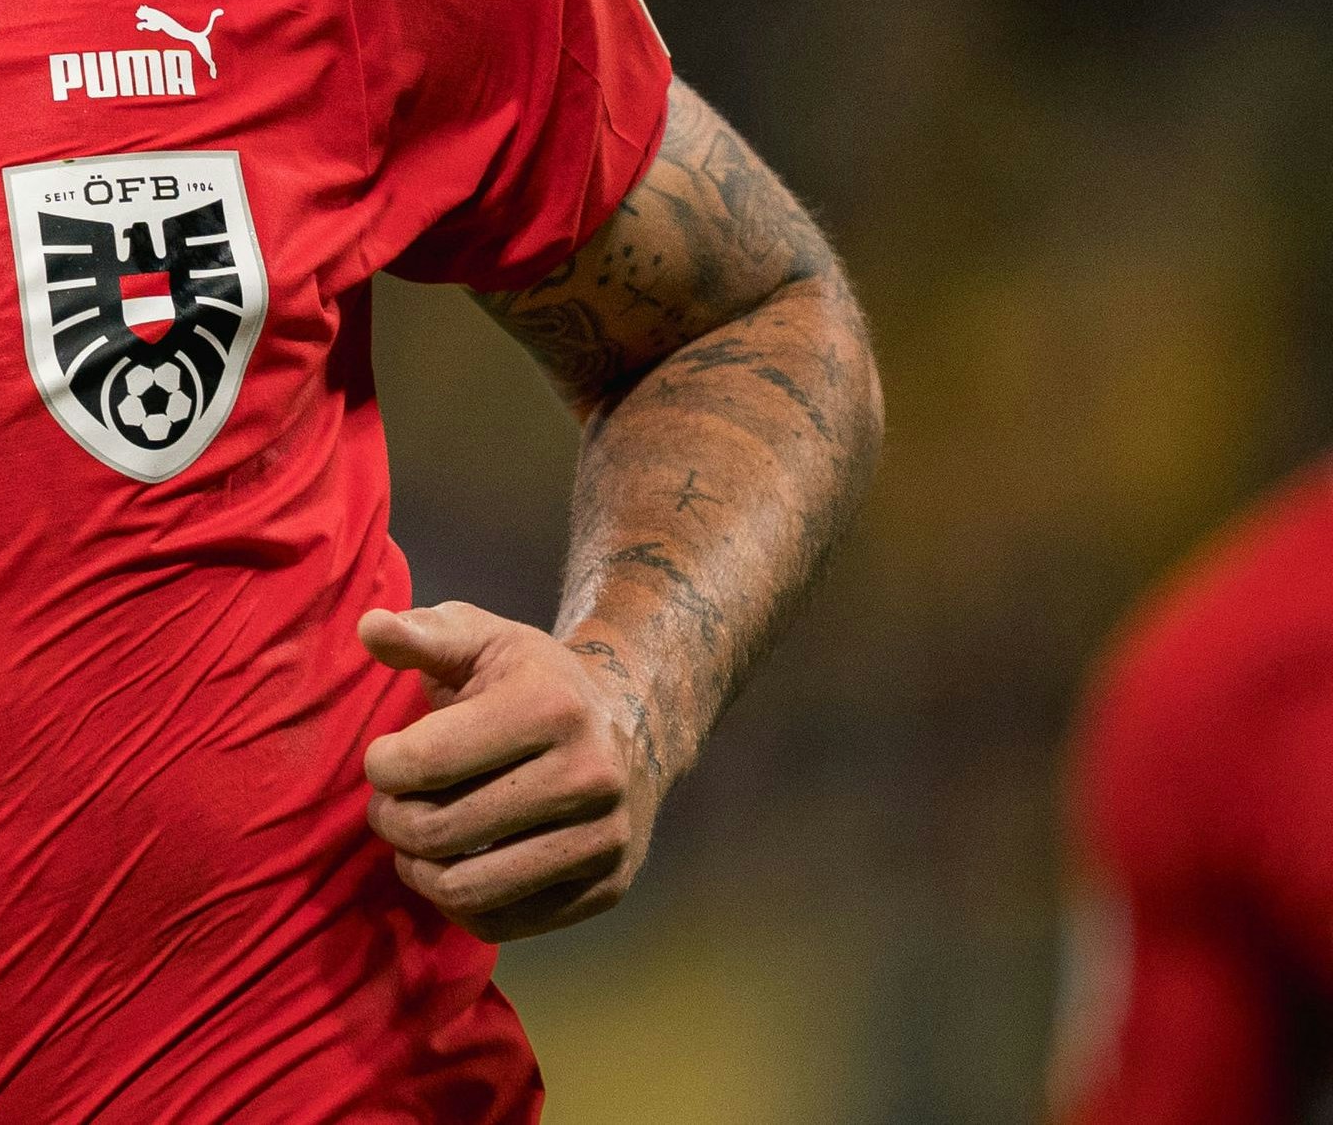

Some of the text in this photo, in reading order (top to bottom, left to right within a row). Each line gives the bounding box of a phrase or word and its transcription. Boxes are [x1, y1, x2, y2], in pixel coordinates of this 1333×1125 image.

[49, 49, 196, 102] PUMA
[44, 174, 214, 206] SEIT ÖFB 1904
